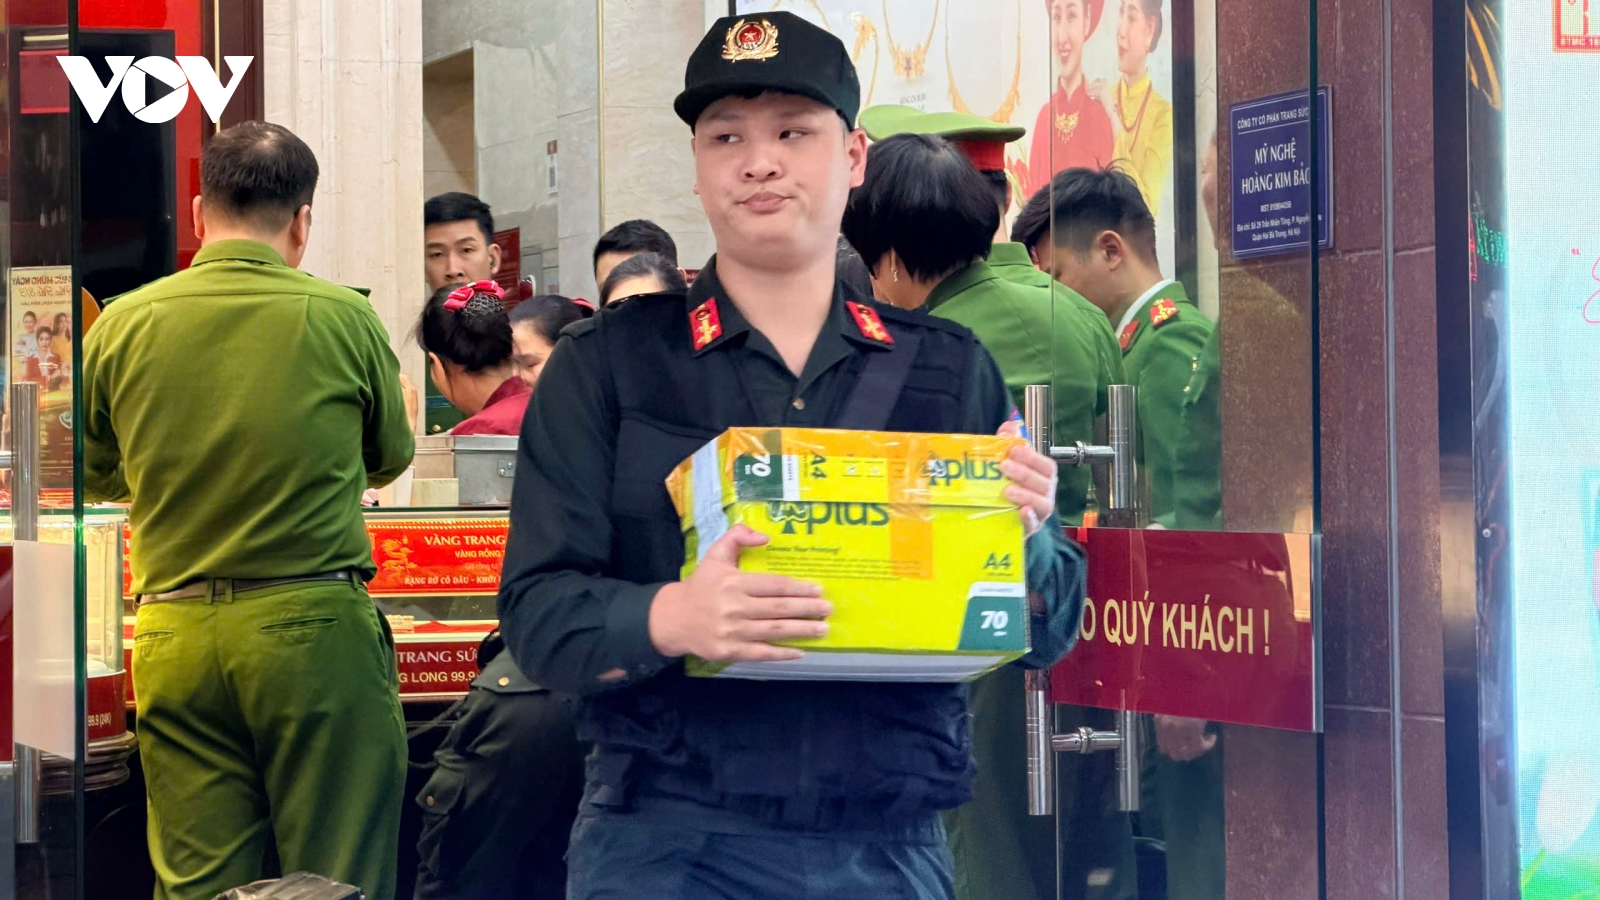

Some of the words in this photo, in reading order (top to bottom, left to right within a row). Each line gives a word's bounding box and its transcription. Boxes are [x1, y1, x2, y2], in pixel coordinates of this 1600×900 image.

[1237, 118, 1251, 130] CÔNG
[1252, 116, 1259, 128] TY
[1280, 109, 1297, 120] TRANG
[1254, 142, 1268, 165] MỸ
[1270, 136, 1296, 162] NGHỆ
[1242, 171, 1273, 194] HOÀNG
[1274, 170, 1292, 189] KIM
[752, 452, 772, 476] 70
[810, 452, 826, 478] A4
[945, 450, 1003, 486] plus
[807, 502, 890, 534] plus
[424, 534, 461, 546] VÀNG
[463, 534, 506, 546] TRANG
[455, 549, 477, 558] VÀNG
[983, 552, 1012, 570] A4
[404, 576, 426, 586] RẠNG
[980, 610, 1008, 630] 70
[1103, 590, 1155, 647] QUÝ
[1162, 594, 1254, 655] KHÁCH
[397, 650, 452, 663] TRANG
[456, 646, 478, 662] SỨ
[412, 672, 448, 683] LONG
[451, 671, 478, 682] 99.9
